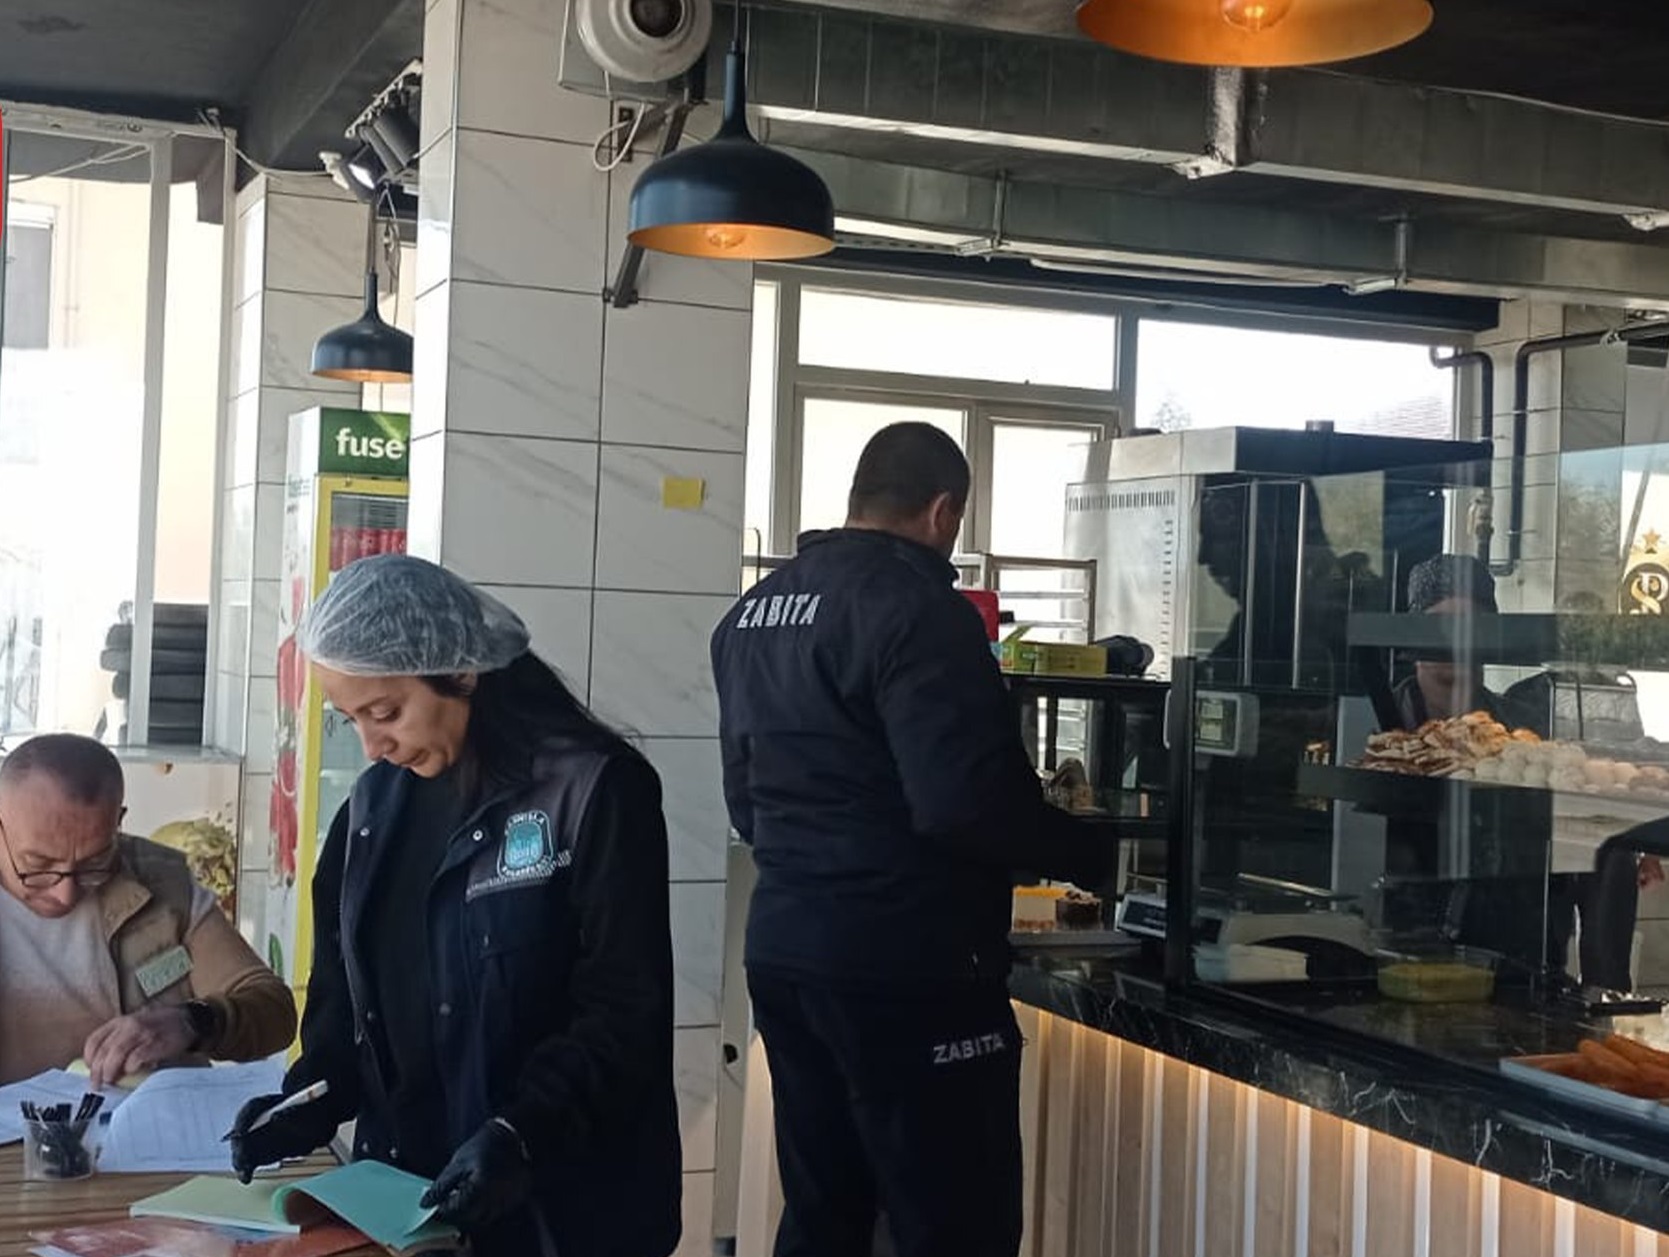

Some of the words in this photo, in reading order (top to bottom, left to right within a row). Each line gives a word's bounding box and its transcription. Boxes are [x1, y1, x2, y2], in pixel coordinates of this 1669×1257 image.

[336, 427, 406, 460] fuse
[736, 593, 821, 629] ZABITA
[933, 1033, 1005, 1064] ZABITA
